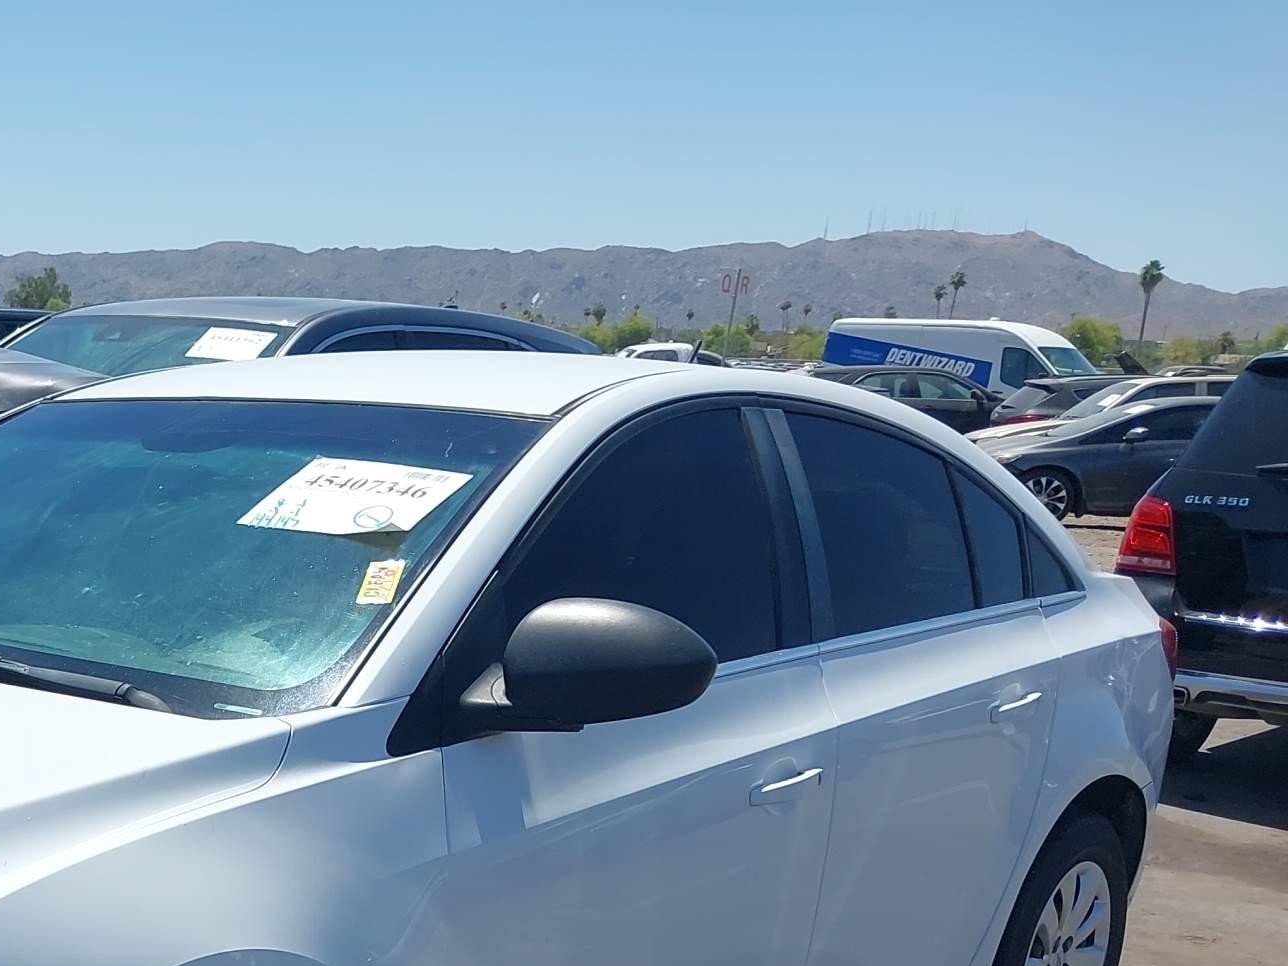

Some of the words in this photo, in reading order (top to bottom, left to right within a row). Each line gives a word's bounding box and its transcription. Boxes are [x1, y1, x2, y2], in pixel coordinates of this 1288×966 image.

[740, 276, 750, 295] R
[304, 474, 431, 499] 45407346
[1184, 495, 1213, 505] GLK
[1216, 496, 1249, 507] 350
